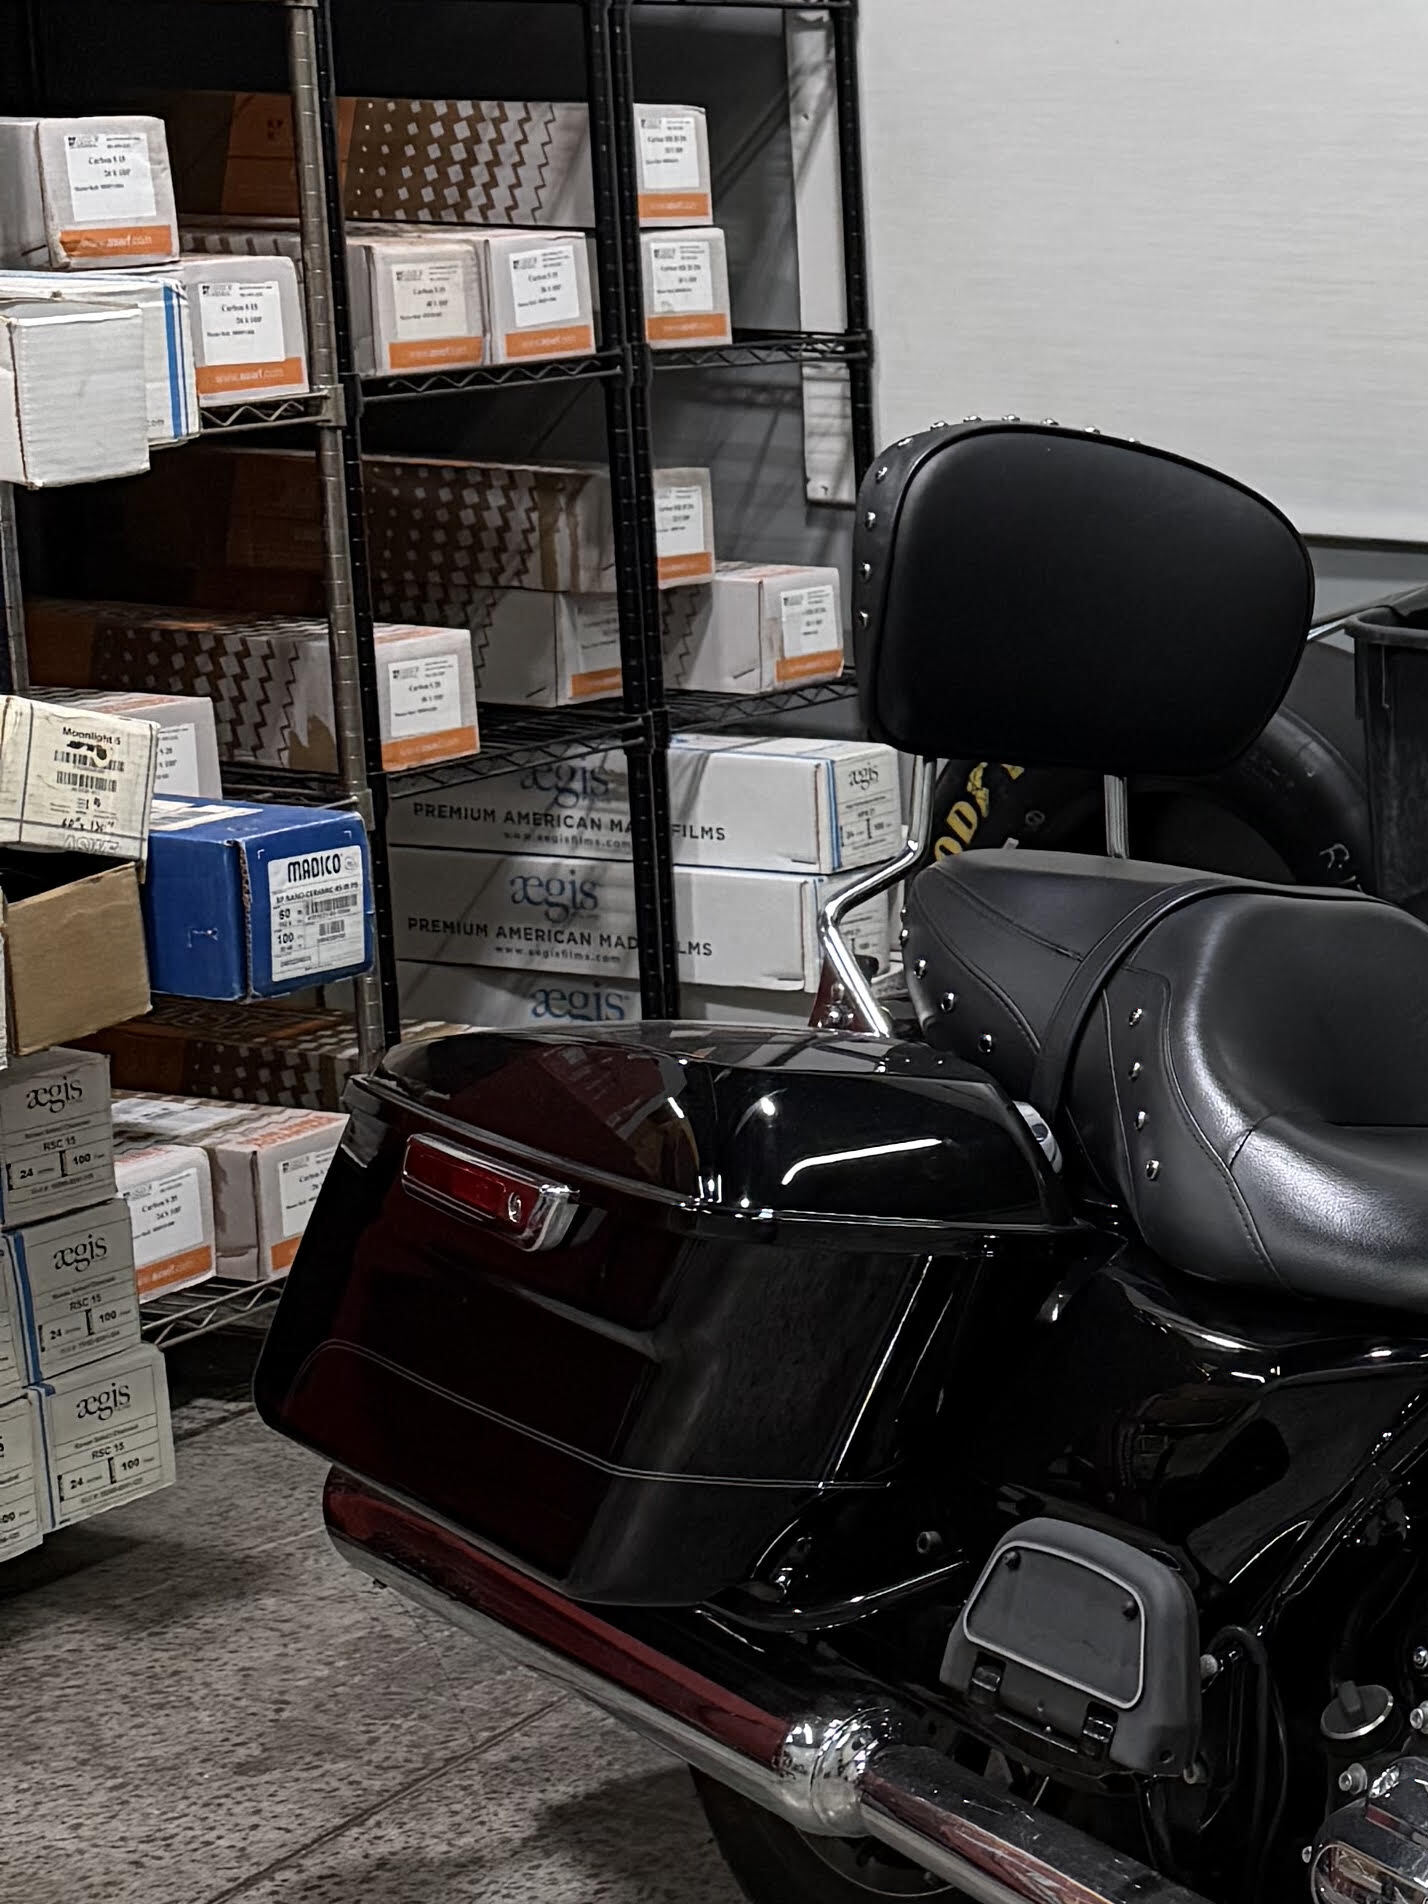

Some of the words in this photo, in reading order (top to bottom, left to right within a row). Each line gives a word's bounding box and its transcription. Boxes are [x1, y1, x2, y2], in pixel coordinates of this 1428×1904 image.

[63, 727, 113, 744] Moonlight
[413, 802, 497, 823] PREMIUM
[503, 810, 602, 832] AMERICAN
[609, 815, 633, 833] MA
[288, 853, 341, 884] MADICO
[278, 932, 294, 944] 100
[408, 917, 488, 938] PREMIUM
[495, 925, 592, 946] AMERICAN
[599, 933, 637, 951] MAD
[43, 1138, 62, 1151] RSC
[20, 1168, 33, 1179] 24
[73, 1153, 91, 1165] 100
[50, 1328, 62, 1340] 24
[99, 1310, 117, 1323] 100
[91, 1446, 112, 1460] RSC
[114, 1442, 125, 1452] 15
[70, 1478, 83, 1490] 24
[121, 1458, 140, 1471] 100
